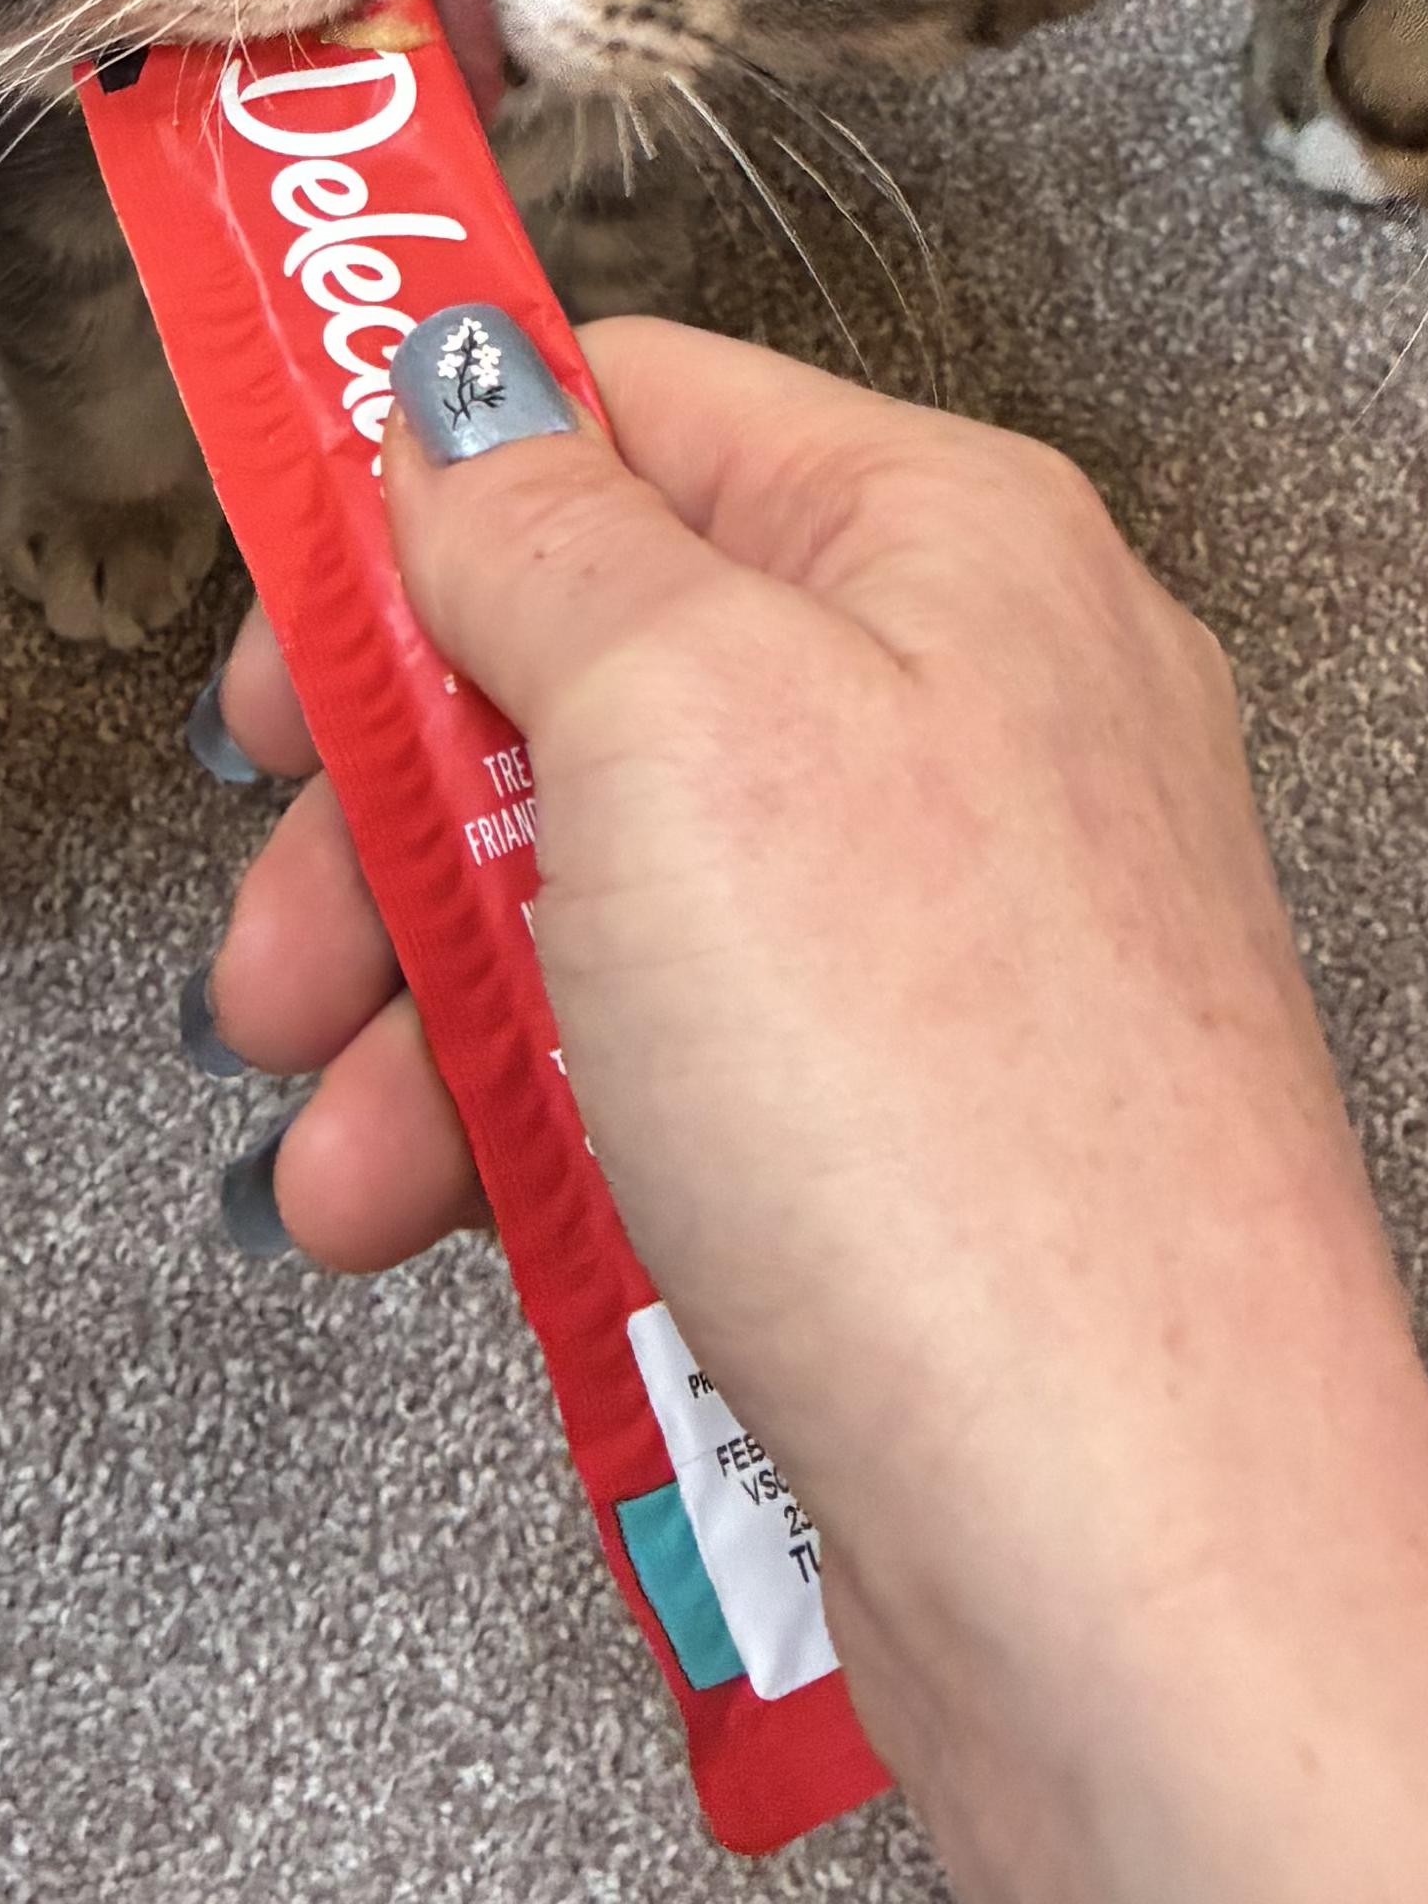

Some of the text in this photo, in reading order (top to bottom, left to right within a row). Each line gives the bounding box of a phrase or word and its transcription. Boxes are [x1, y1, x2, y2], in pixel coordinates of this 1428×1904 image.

[221, 50, 467, 478] Delec
[483, 746, 532, 798] TRE
[688, 1370, 714, 1399] PR
